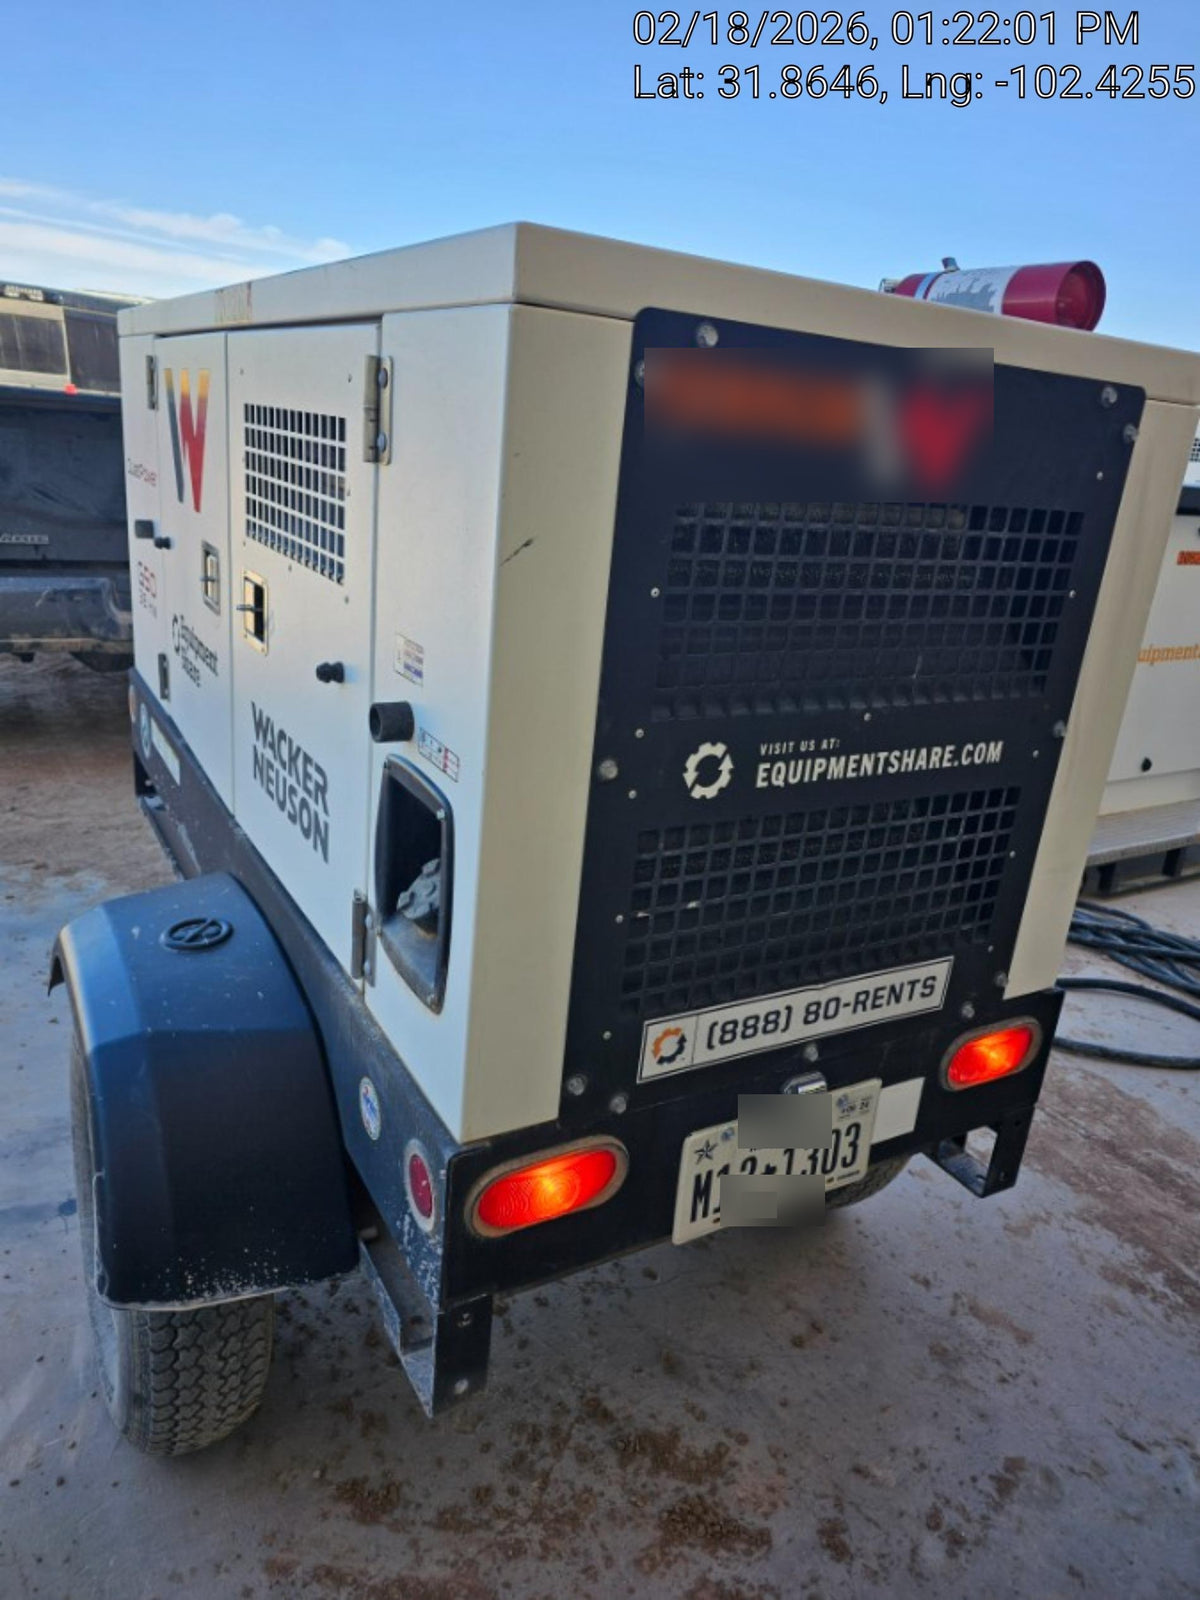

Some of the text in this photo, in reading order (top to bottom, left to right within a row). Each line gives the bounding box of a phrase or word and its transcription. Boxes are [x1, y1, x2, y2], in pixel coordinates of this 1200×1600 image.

[251, 700, 330, 817] WACKER
[756, 741, 1004, 788] EQUIPMENTSHARE.COM
[760, 738, 841, 756] VISIT US AT:
[253, 744, 330, 864] NEUSON
[707, 975, 937, 1050] (888) 80-RENTS
